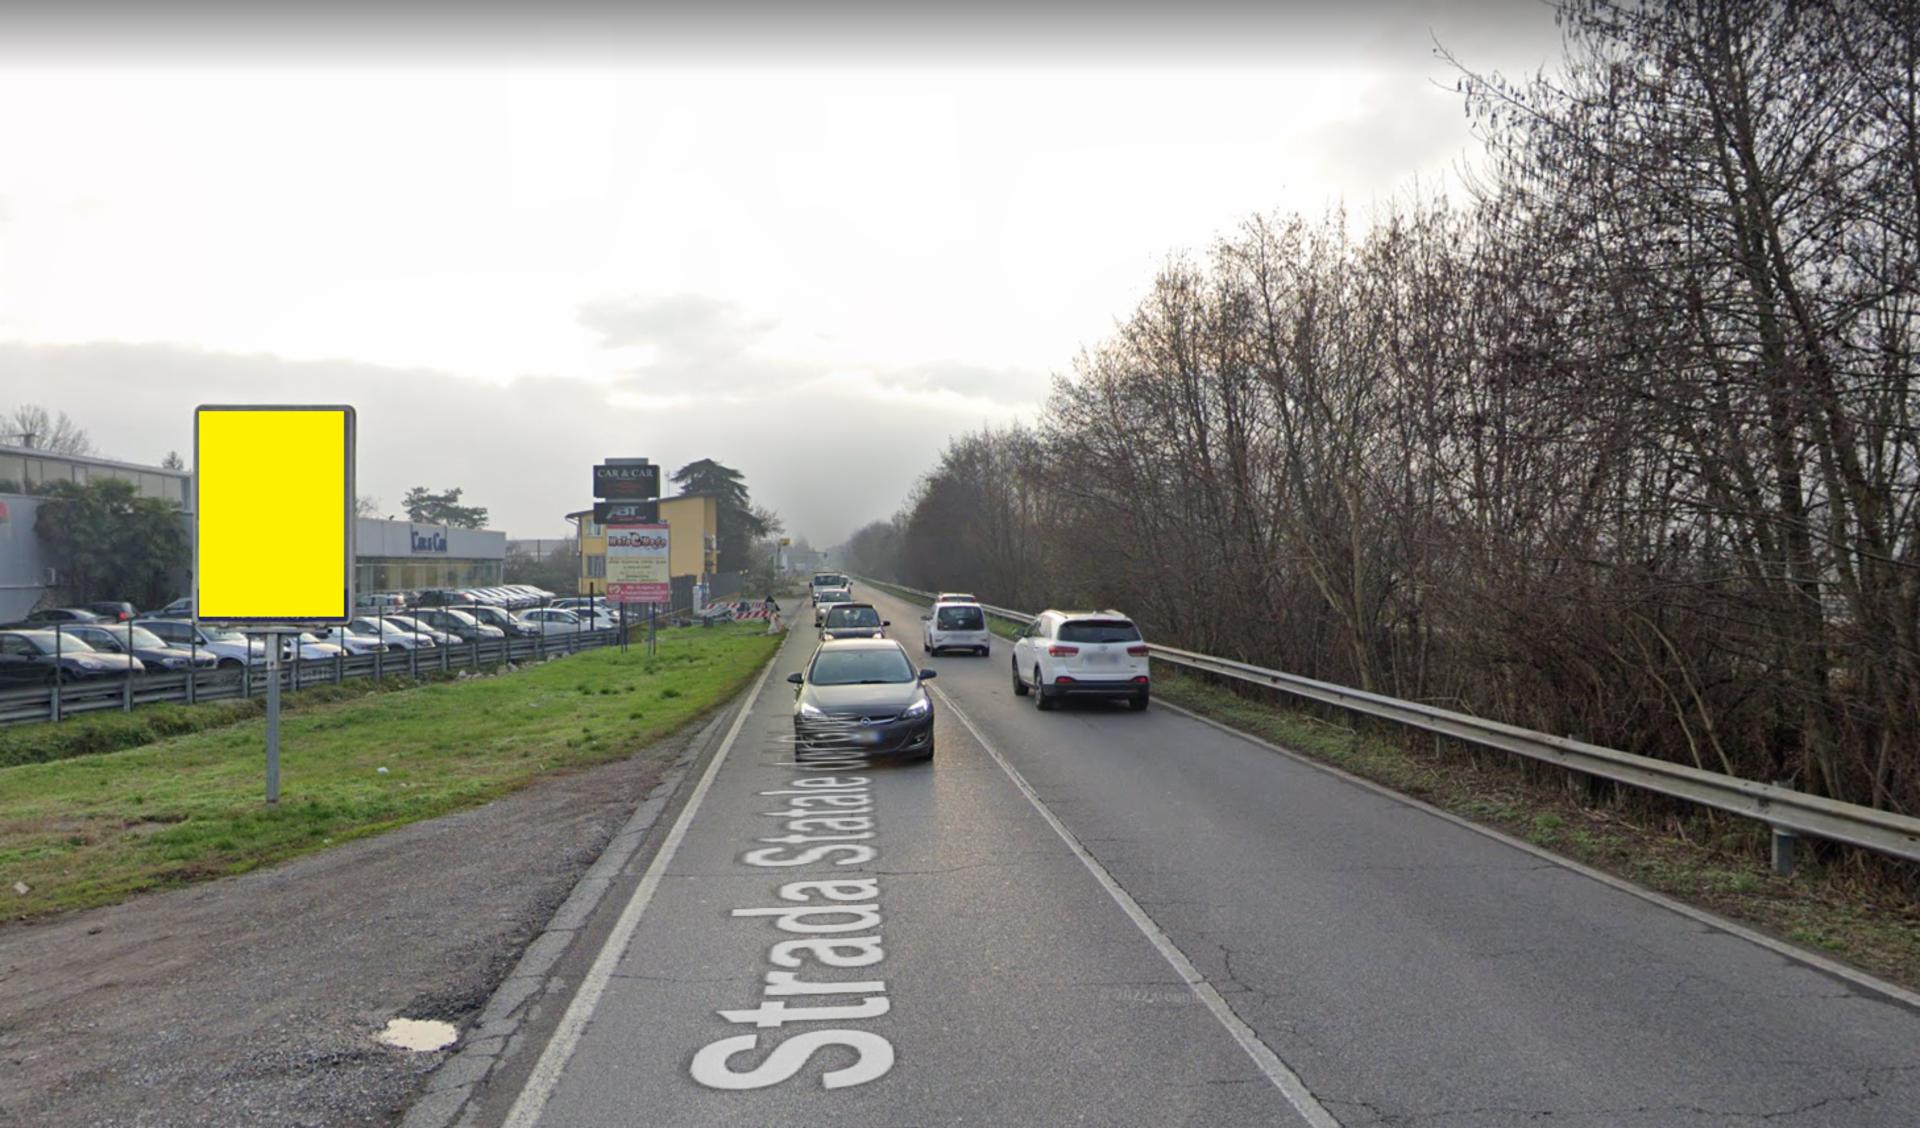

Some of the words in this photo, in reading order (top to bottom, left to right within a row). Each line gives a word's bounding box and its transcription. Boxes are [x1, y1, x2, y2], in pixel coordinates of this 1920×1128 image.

[597, 469, 619, 478] CAR
[620, 469, 629, 478] &
[631, 469, 654, 478] CAR
